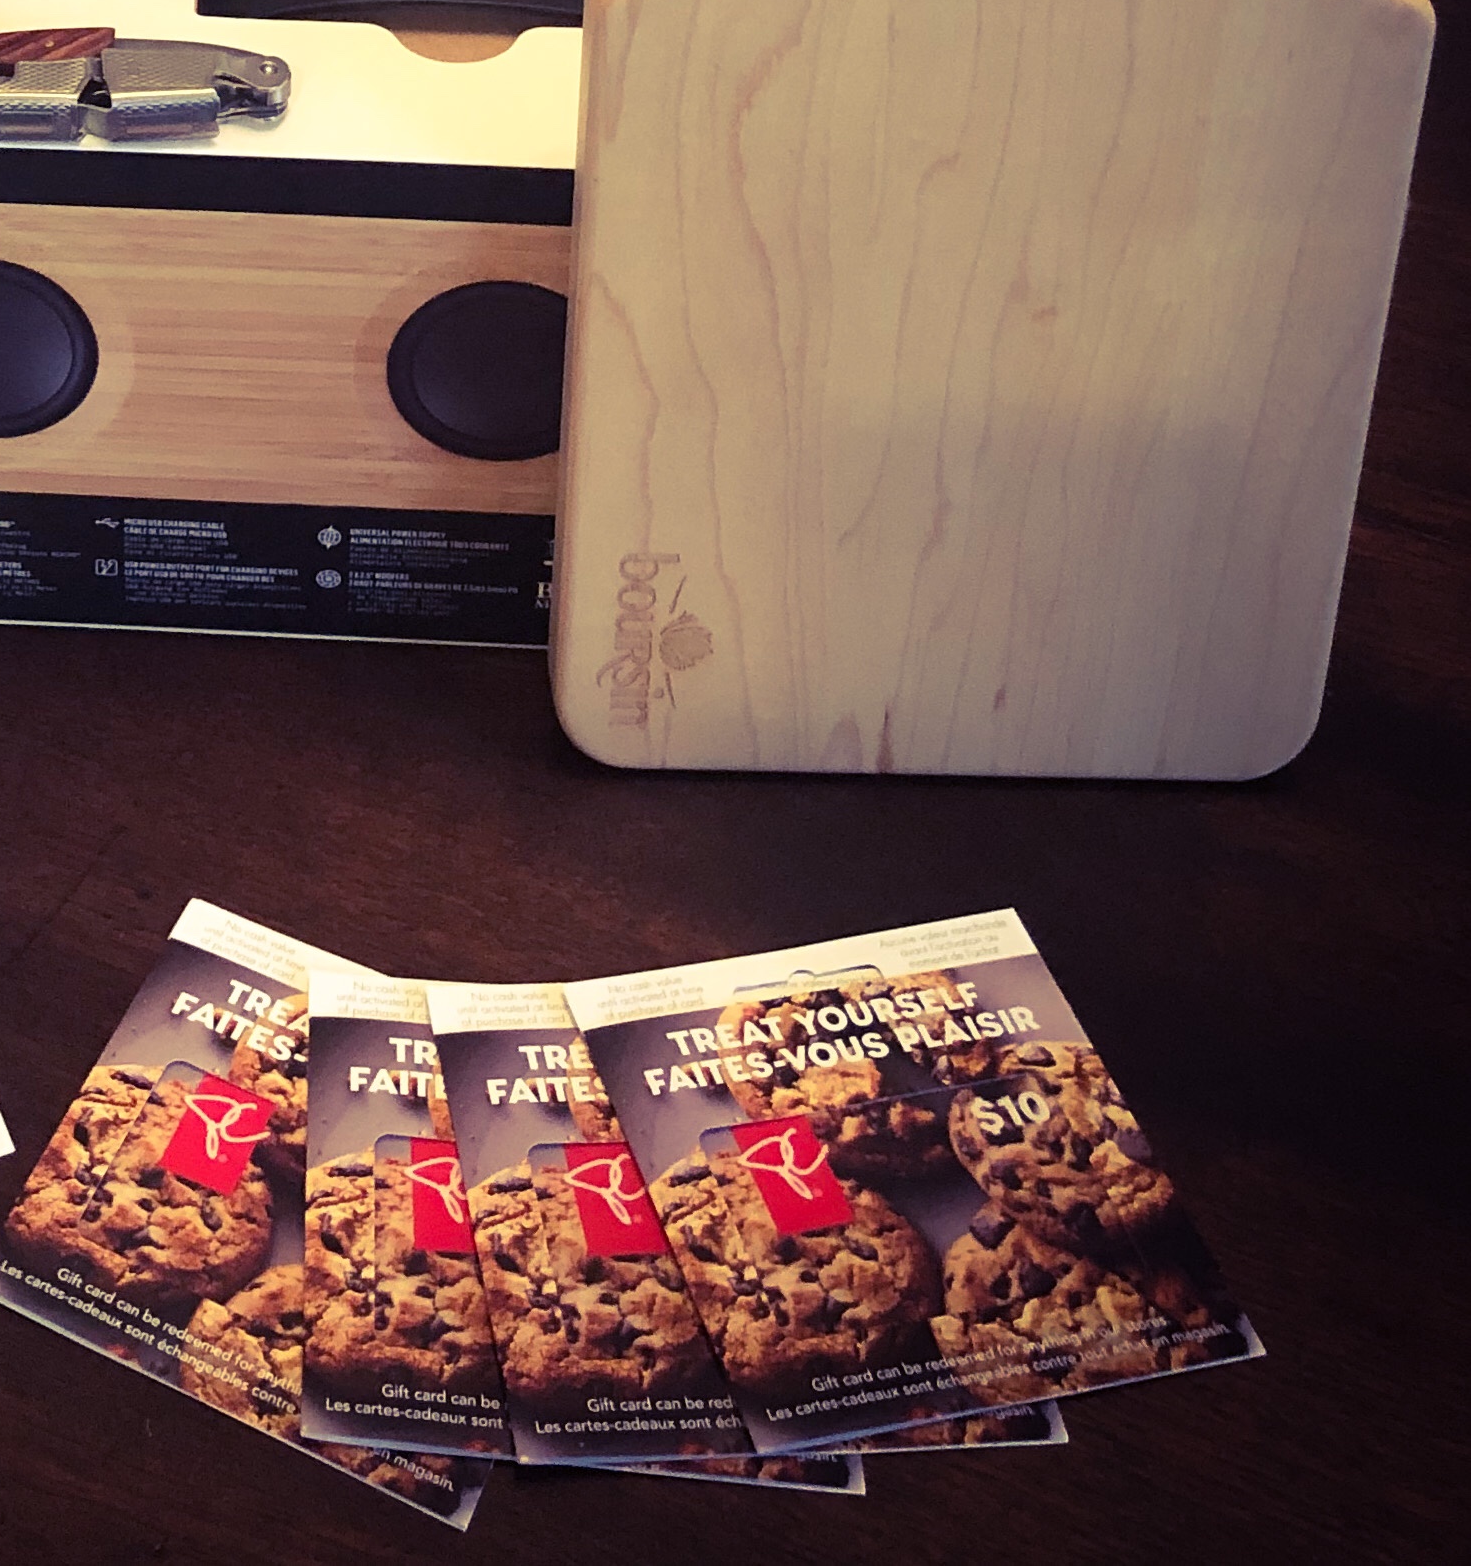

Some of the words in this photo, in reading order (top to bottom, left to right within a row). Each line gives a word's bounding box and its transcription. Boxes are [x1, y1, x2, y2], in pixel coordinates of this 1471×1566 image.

[227, 978, 309, 1037] TREA
[666, 1016, 786, 1056] TREAT
[790, 982, 979, 1037] YOURSELF
[643, 1031, 890, 1096] FAITES-VOUS
[891, 1005, 1041, 1053] PLAISIR
[970, 1089, 1051, 1137] $10
[0, 1259, 24, 1281] Les
[24, 1272, 125, 1330] cartes-cadeaux
[124, 1321, 157, 1346] sont
[156, 1338, 250, 1392] échangeables
[251, 1384, 298, 1415] contre
[56, 1267, 83, 1289] Gift
[84, 1282, 118, 1305] card
[116, 1298, 141, 1320] can
[142, 1307, 162, 1328] be
[162, 1320, 234, 1364] redeemed
[234, 1353, 257, 1374] for
[766, 1407, 793, 1423] Les
[794, 1385, 901, 1416] cartes-cadeaux
[901, 1379, 935, 1396] sont
[935, 1362, 1031, 1392] échangeables
[1032, 1353, 1078, 1373] contre
[1151, 1334, 1172, 1348] en
[1172, 1322, 1231, 1345] magasin
[811, 1374, 841, 1393] Gift
[842, 1368, 874, 1387] card
[875, 1366, 902, 1382] can
[901, 1361, 923, 1376] be
[924, 1344, 996, 1371] redeemed
[997, 1343, 1018, 1357] for
[1022, 1333, 1082, 1354] anything
[325, 1397, 351, 1413] Les
[354, 1402, 467, 1425] cartes-cadeaux
[471, 1415, 505, 1430] sont
[381, 1383, 410, 1400] Gift
[414, 1389, 447, 1404] card
[450, 1394, 477, 1407] can
[480, 1394, 501, 1410] be
[534, 1420, 562, 1435] Les
[564, 1416, 677, 1434] cartes-cadeaux
[679, 1415, 712, 1430] sont
[586, 1396, 616, 1413] Gift
[619, 1396, 653, 1412] card
[655, 1398, 682, 1411] can
[684, 1394, 705, 1411] be
[394, 1455, 455, 1493] magasin
